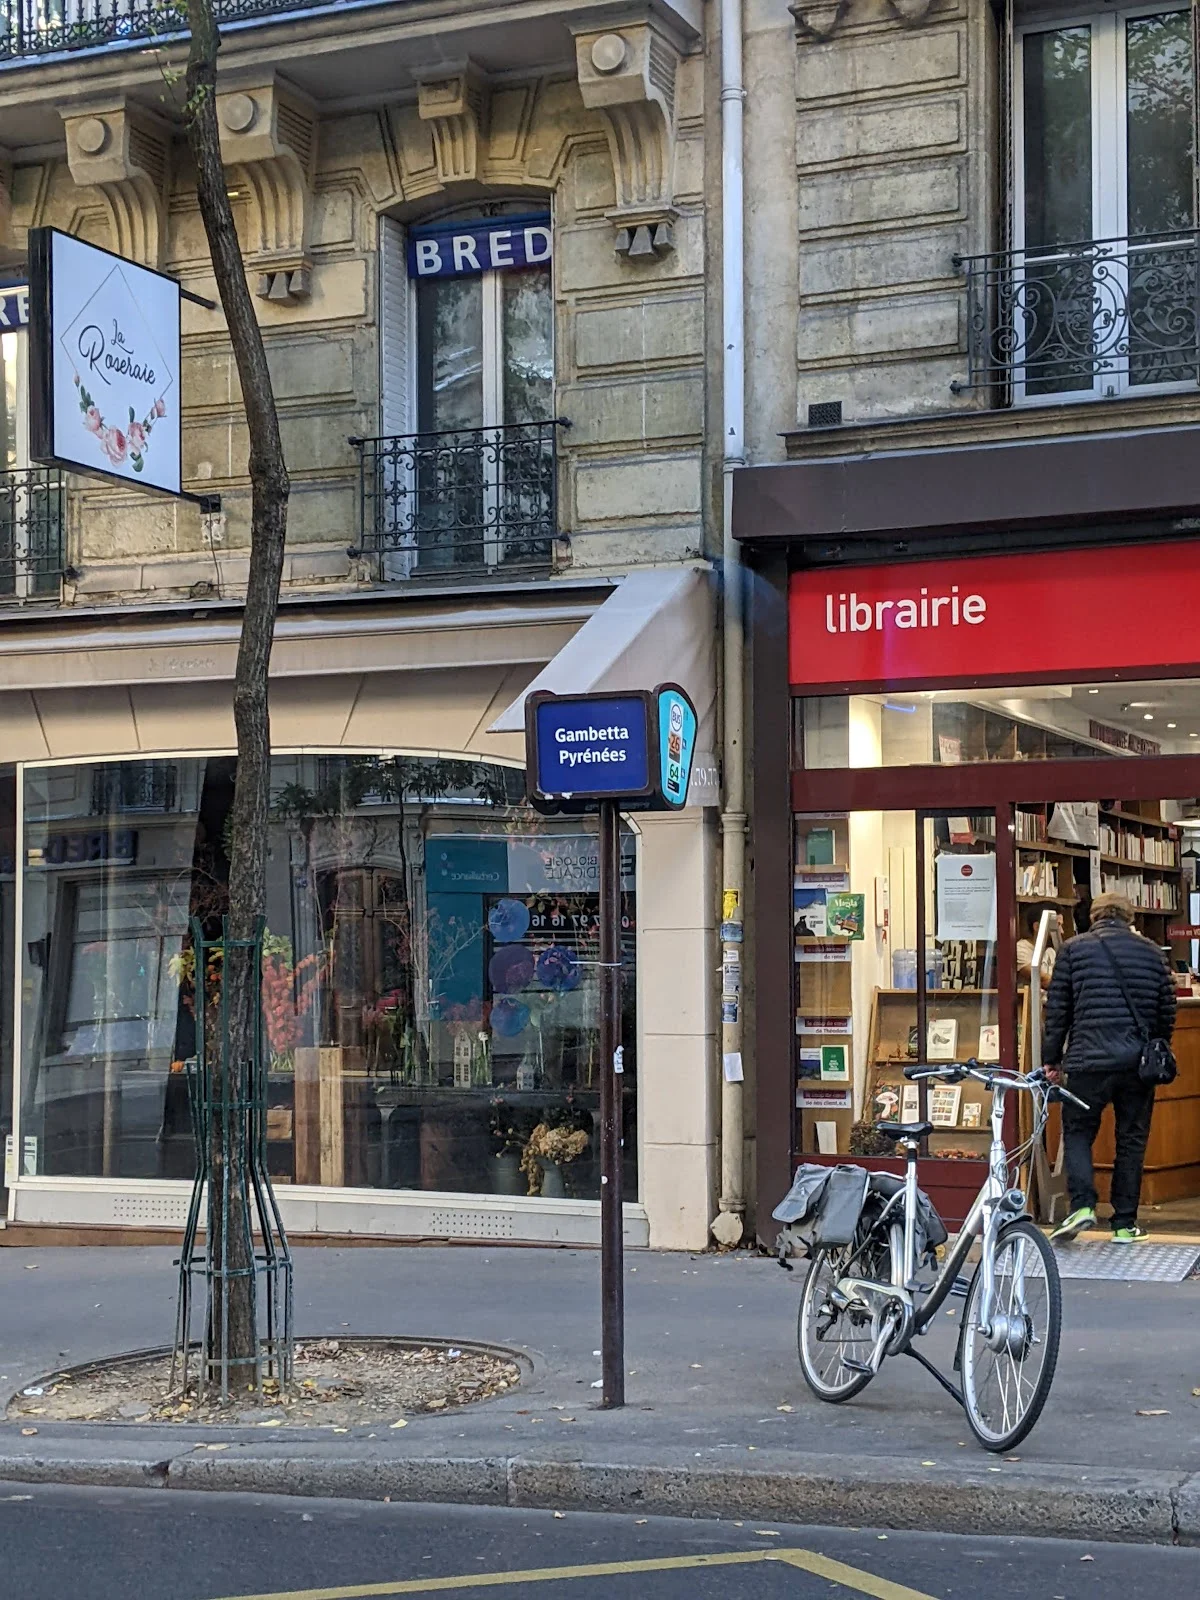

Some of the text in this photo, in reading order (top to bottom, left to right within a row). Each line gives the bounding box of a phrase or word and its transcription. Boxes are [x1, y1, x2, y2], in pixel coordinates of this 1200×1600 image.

[416, 226, 552, 275] BRED
[111, 318, 134, 354] La
[78, 325, 156, 386] Roseraie
[826, 586, 987, 633] librairie
[555, 726, 629, 743] Gambetta
[670, 734, 680, 752] 26
[559, 747, 626, 767] Pyrénées
[669, 763, 679, 781] 64
